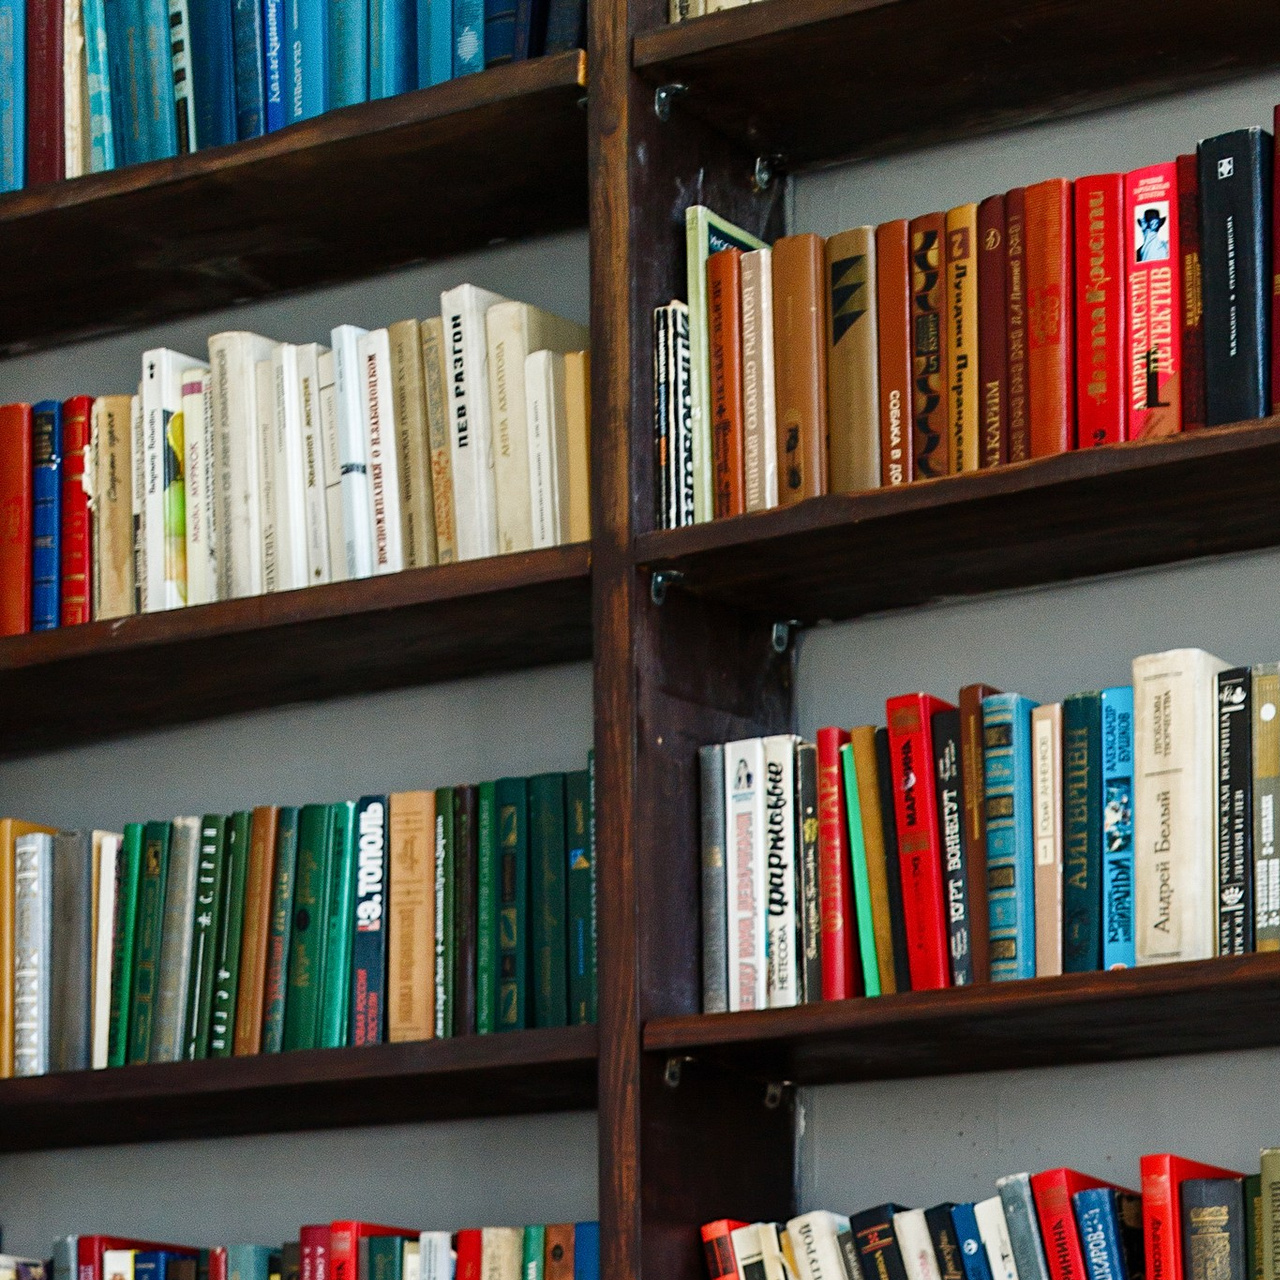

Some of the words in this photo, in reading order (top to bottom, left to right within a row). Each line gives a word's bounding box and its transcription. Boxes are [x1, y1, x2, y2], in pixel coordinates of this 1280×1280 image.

[953, 263, 967, 349] Луиджи
[1130, 269, 1149, 411] АМЕРИКАНСКИЙ
[1150, 267, 1173, 375] ДЕТЕКТИВ
[450, 313, 467, 398] РАЗГОН
[366, 352, 383, 447] Н.ЗАБОЛОЦКОМ
[888, 389, 901, 446] СОБАКА
[370, 462, 387, 566] ВОСПОМИНАНИЯ
[1104, 705, 1117, 772] АЛЕКСАНДР
[1117, 711, 1131, 763] БУШКОВ
[1152, 693, 1163, 756] ПРОБЛЕМЫ
[1161, 688, 1172, 757] ТВОРЧЕСТВА
[357, 801, 384, 897] ТОПОЛЬ
[943, 788, 962, 871] ВОННЕГУТ
[1153, 790, 1171, 853] Белый
[356, 894, 382, 920] Э.
[948, 877, 965, 922] КУРТ
[1153, 860, 1173, 934] Андрей
[776, 924, 789, 991] НЕТЕСОВА
